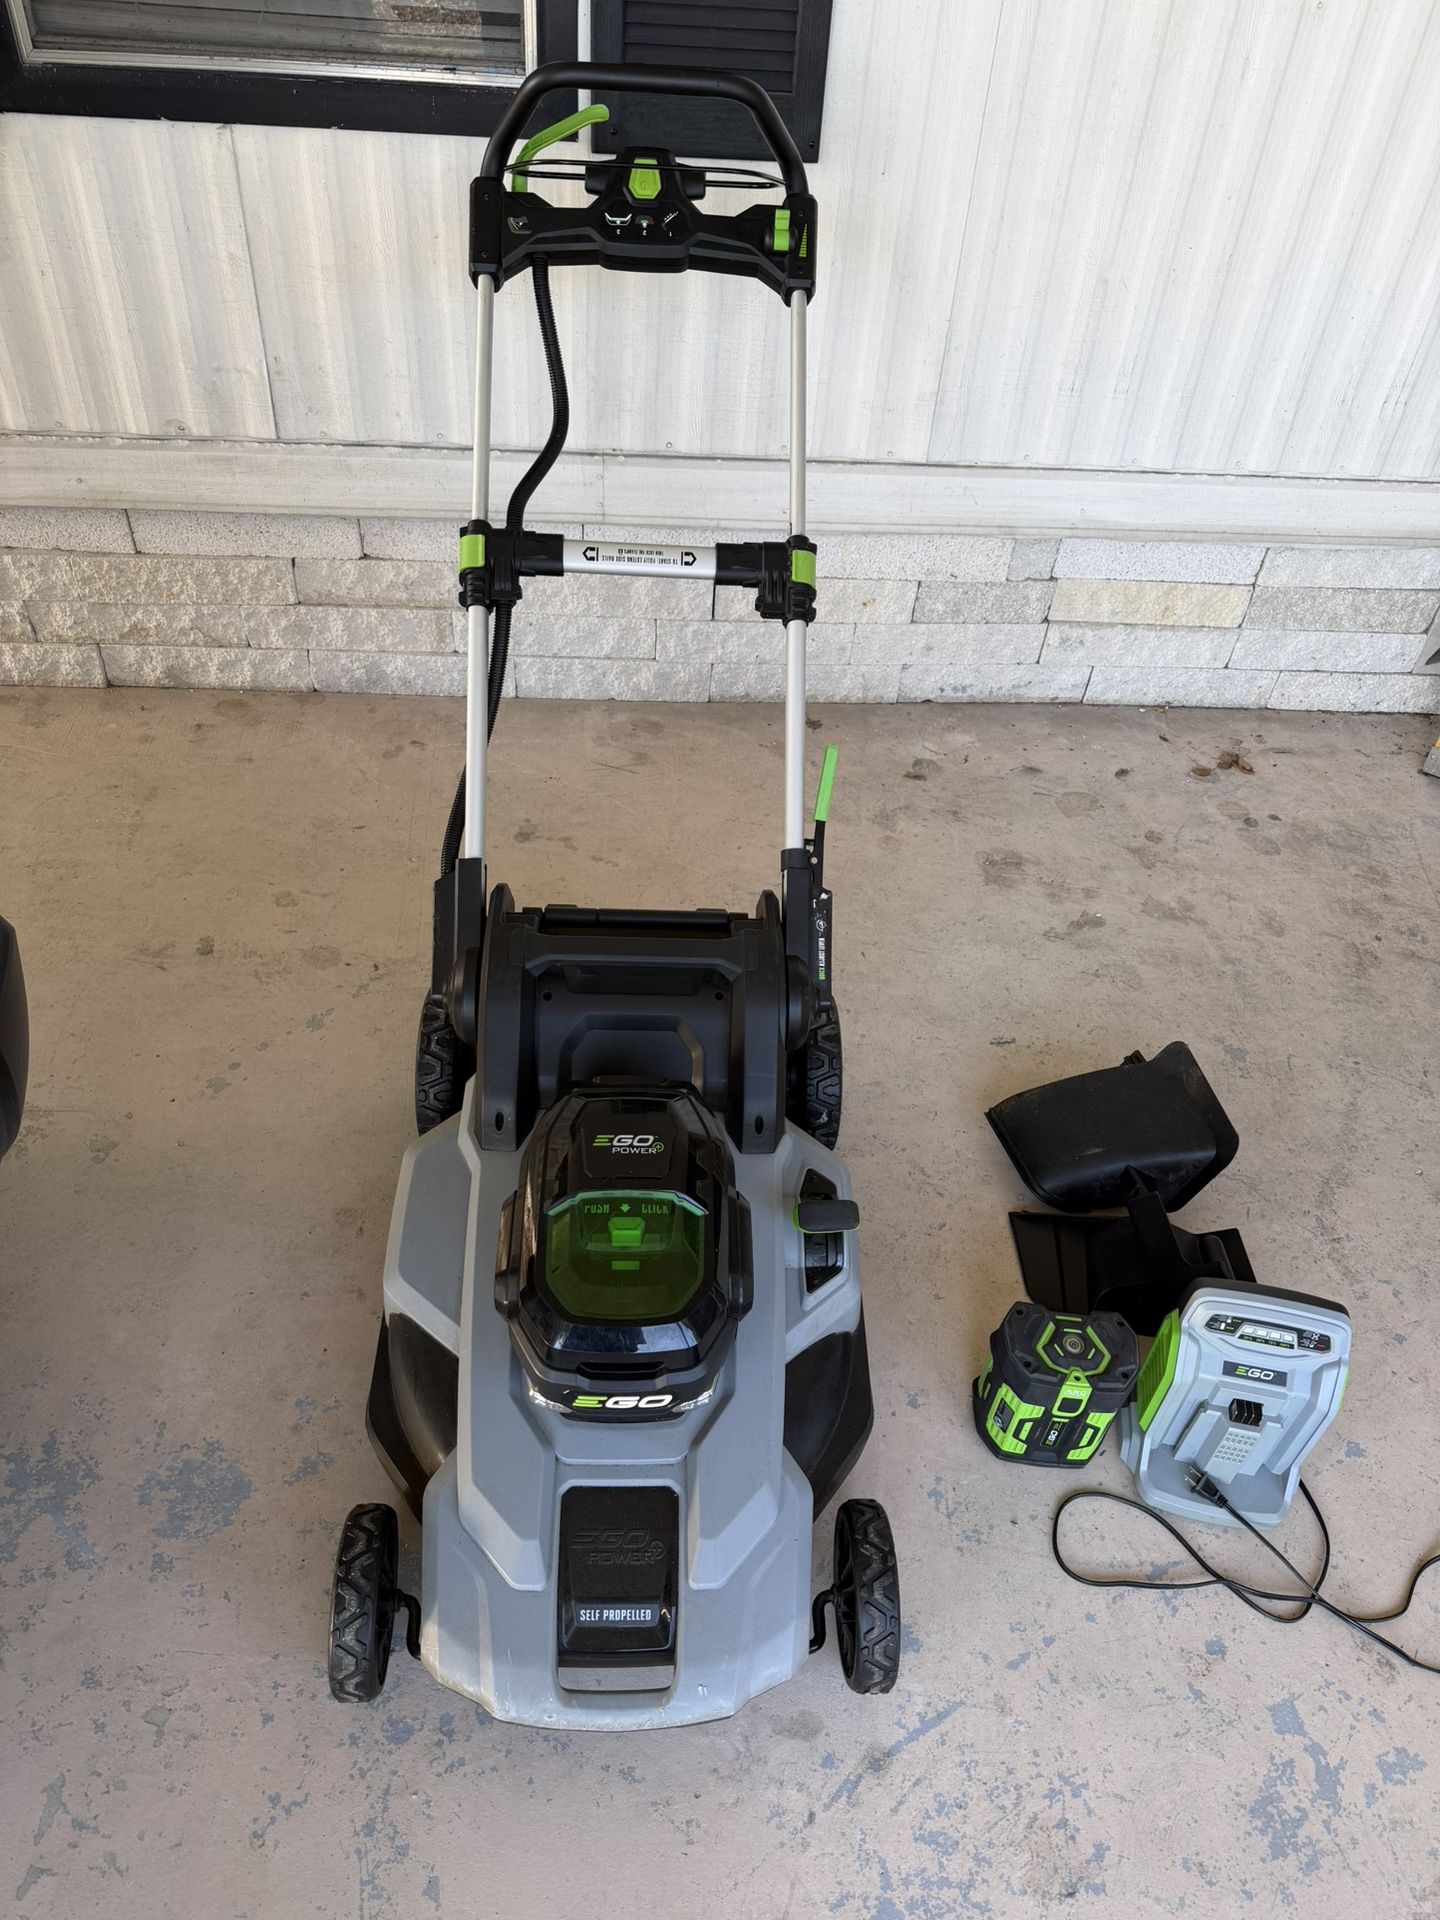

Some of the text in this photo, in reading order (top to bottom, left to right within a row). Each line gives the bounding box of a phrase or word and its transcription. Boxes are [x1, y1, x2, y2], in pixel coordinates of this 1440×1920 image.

[592, 1134, 655, 1147] EGO
[1234, 1366, 1275, 1380] EGO
[572, 1394, 674, 1409] EGO
[573, 1527, 649, 1549] EGO
[579, 1608, 652, 1621] SELF PROPELLED
